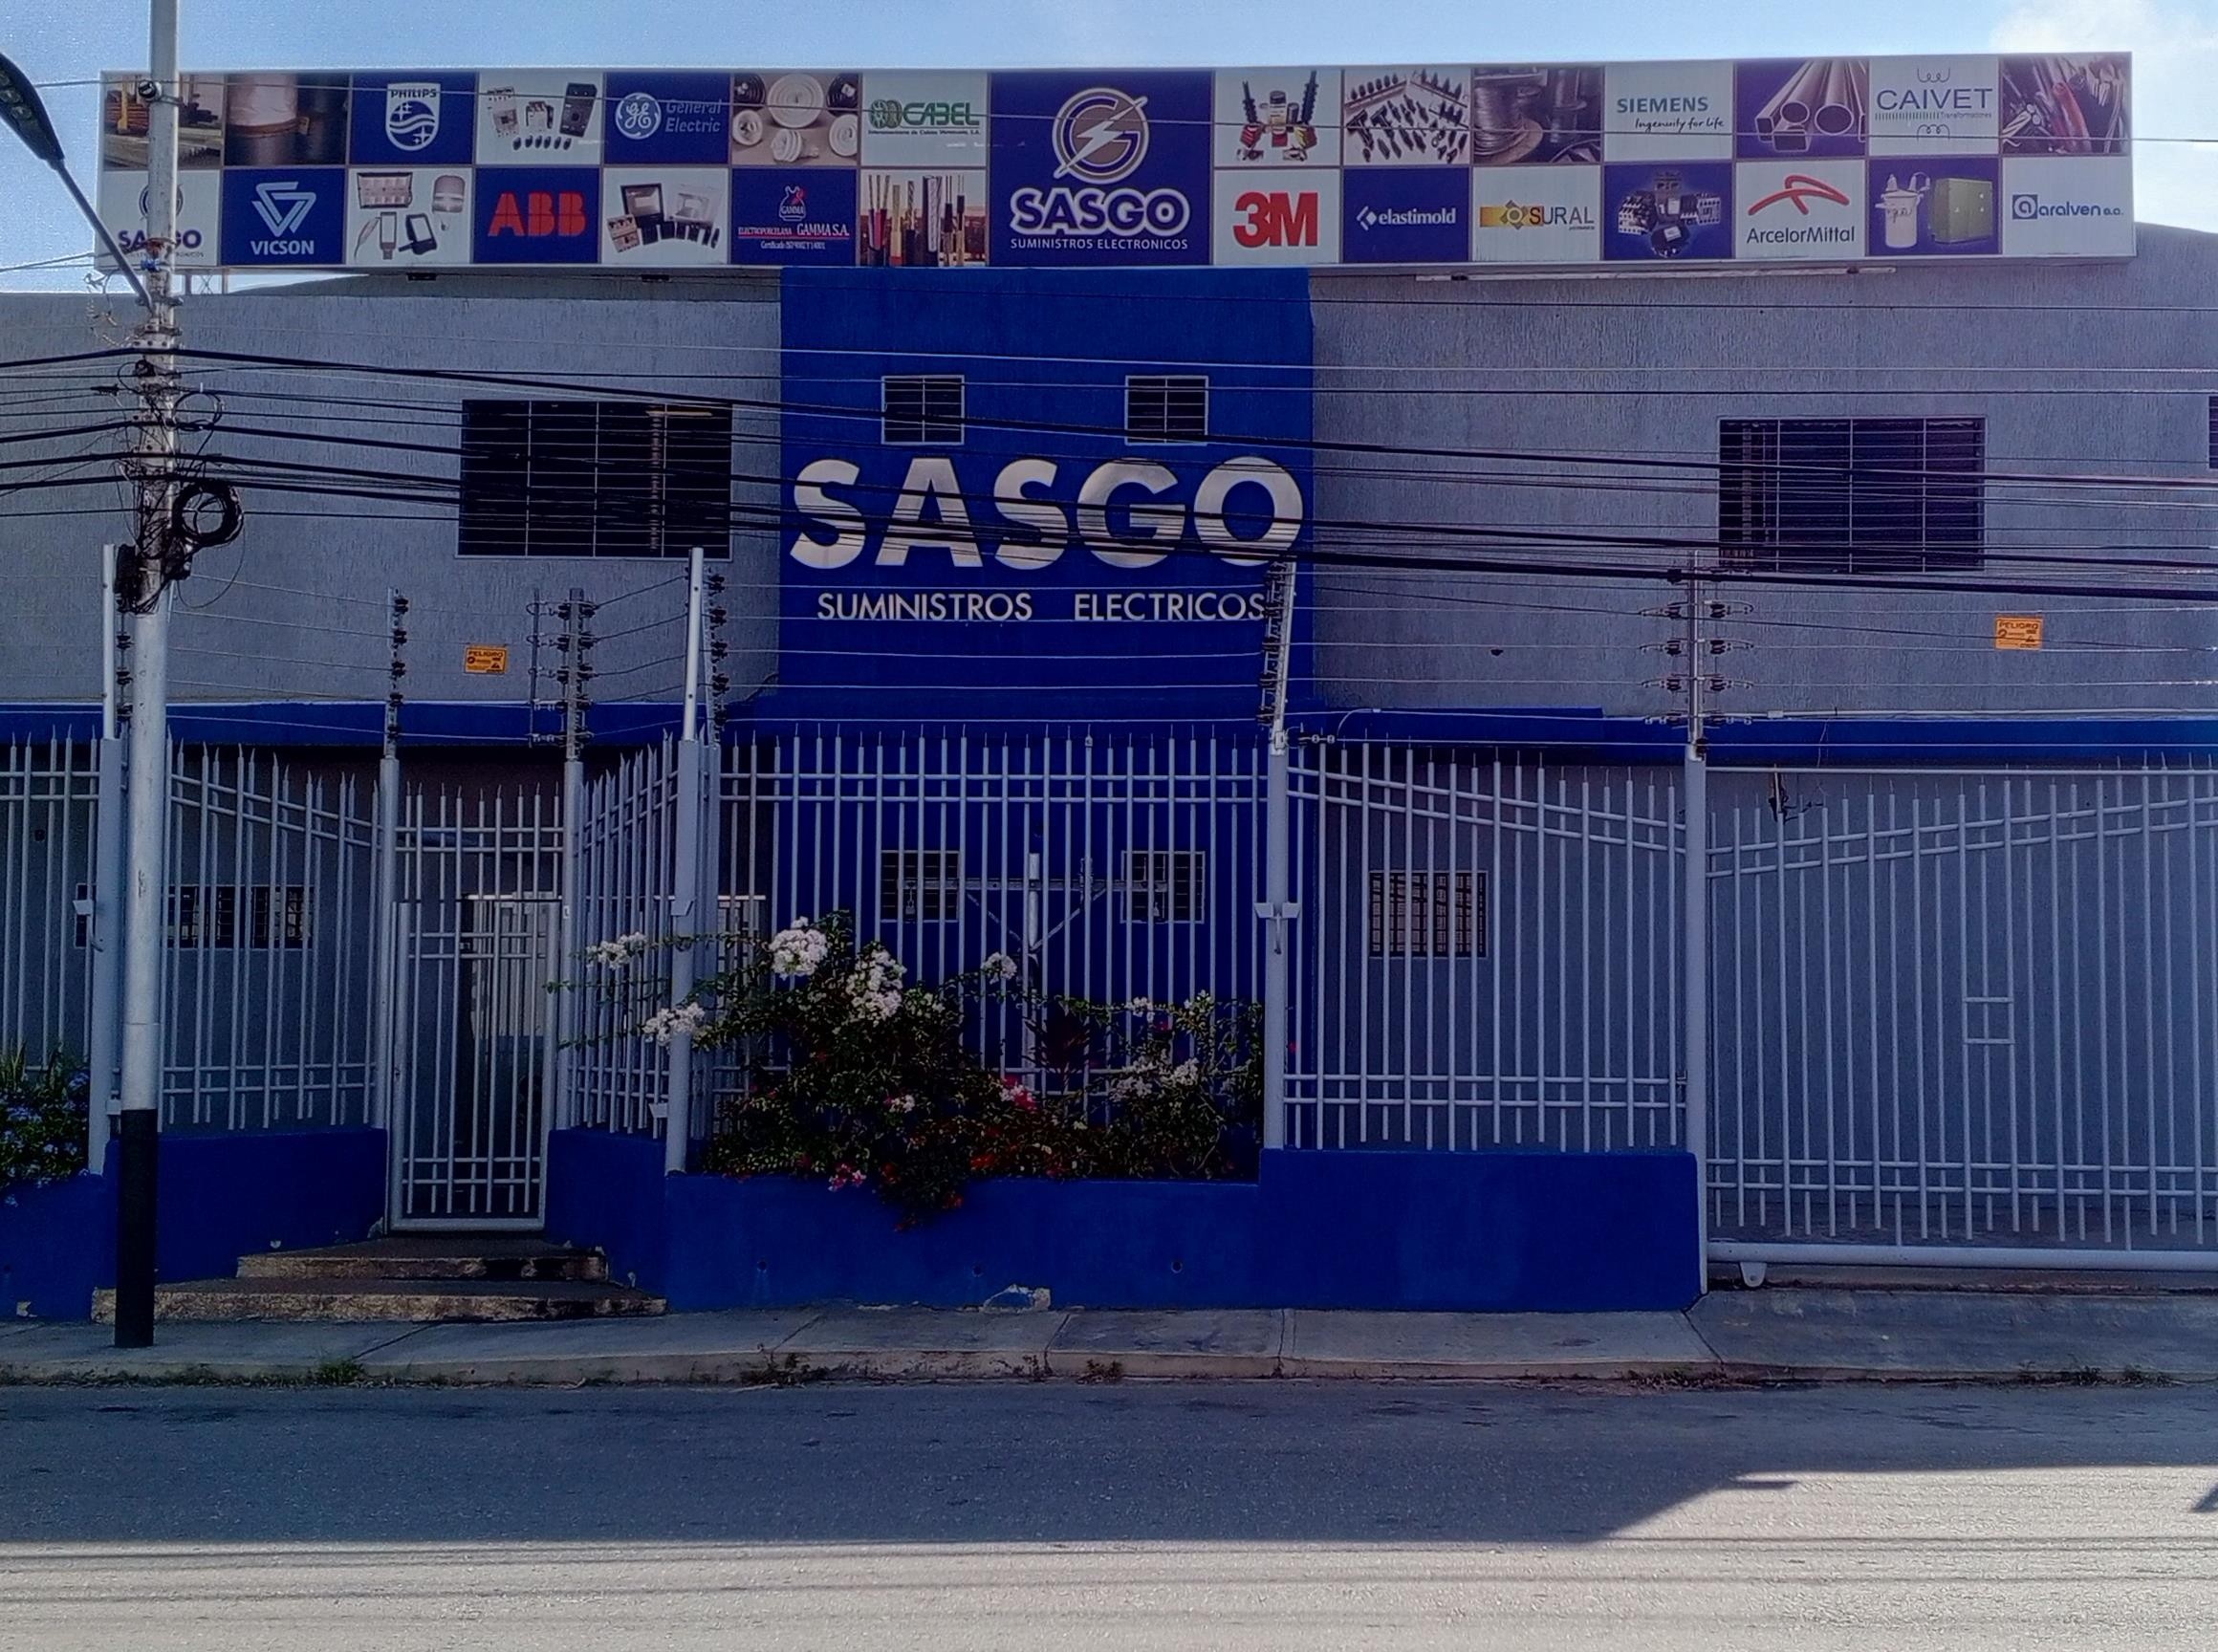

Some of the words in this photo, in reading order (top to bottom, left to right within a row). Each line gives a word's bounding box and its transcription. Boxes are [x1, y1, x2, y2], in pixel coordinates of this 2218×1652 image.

[390, 88, 437, 98] PHILIPS
[1876, 87, 1993, 111] CAIVET
[665, 98, 722, 114] General
[902, 101, 980, 126] CABEL
[1617, 97, 1708, 114] SIEMENS
[664, 117, 721, 133] Electric
[1634, 117, 1686, 134] Ingenuity
[1687, 117, 1706, 130] for
[488, 192, 586, 237] ABB
[1010, 187, 1190, 237] SASGO
[1378, 206, 1456, 226] elastimold
[1529, 206, 1596, 226] SURAL
[2038, 201, 2101, 217] aralven
[796, 223, 831, 237] GAMMA
[1233, 191, 1318, 249] 3M
[118, 228, 203, 250] SAO
[1011, 238, 1093, 250] SUMINISTROS
[1097, 239, 1188, 250] ELECTRONICOS
[1747, 225, 1855, 245] ArcelorMittal
[250, 239, 315, 255] VICSON
[790, 456, 1304, 570] SASGO
[817, 592, 1033, 621] SUMINISTROS
[1074, 592, 1266, 622] ELECTRICOS
